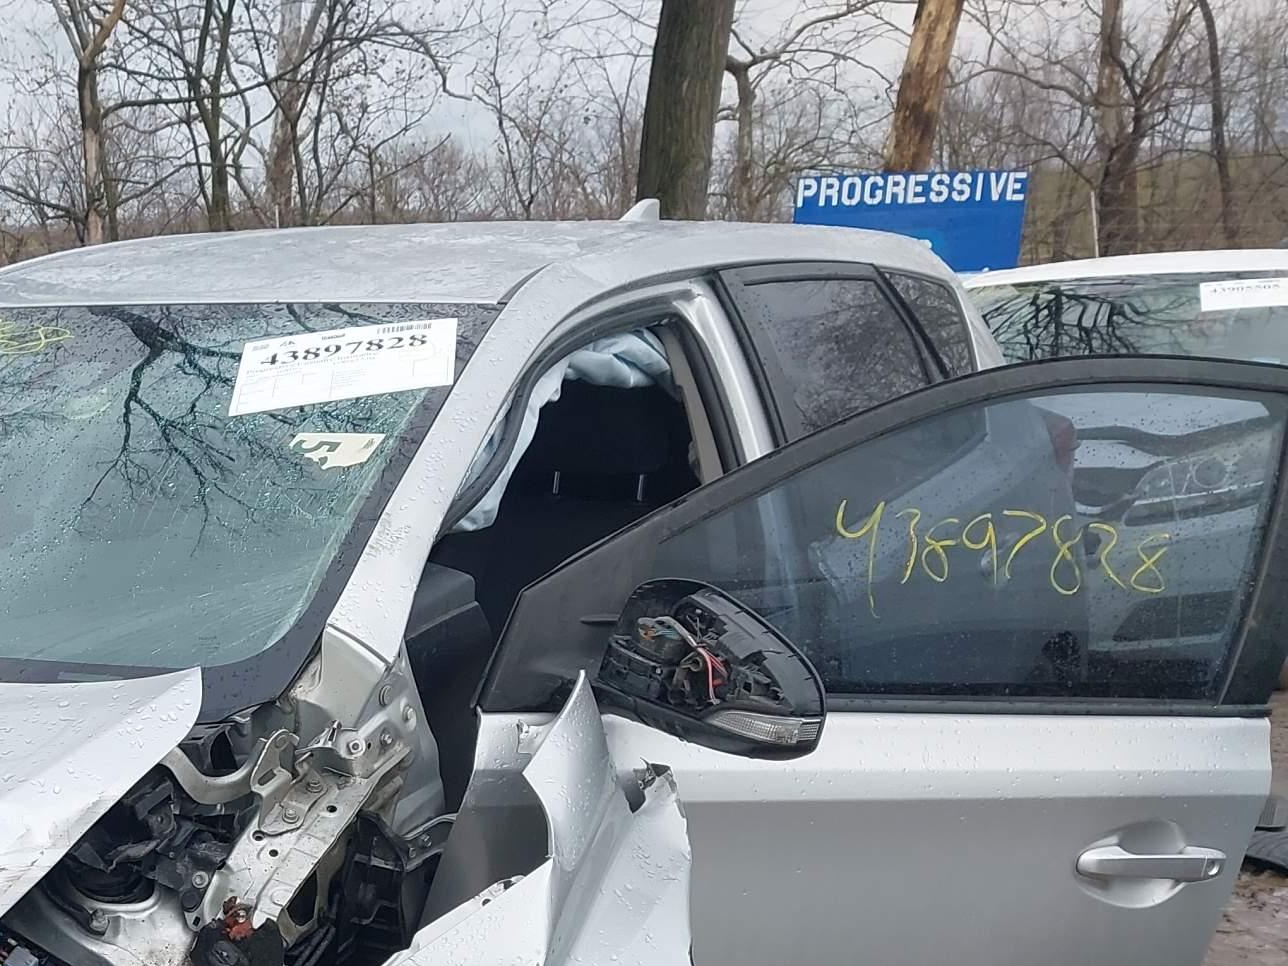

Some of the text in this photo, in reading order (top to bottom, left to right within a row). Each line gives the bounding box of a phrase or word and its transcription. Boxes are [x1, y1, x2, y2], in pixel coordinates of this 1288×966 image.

[797, 172, 1027, 208] PROGRESSIVE
[260, 334, 428, 366] 43897828
[836, 499, 1171, 619] 43897828
